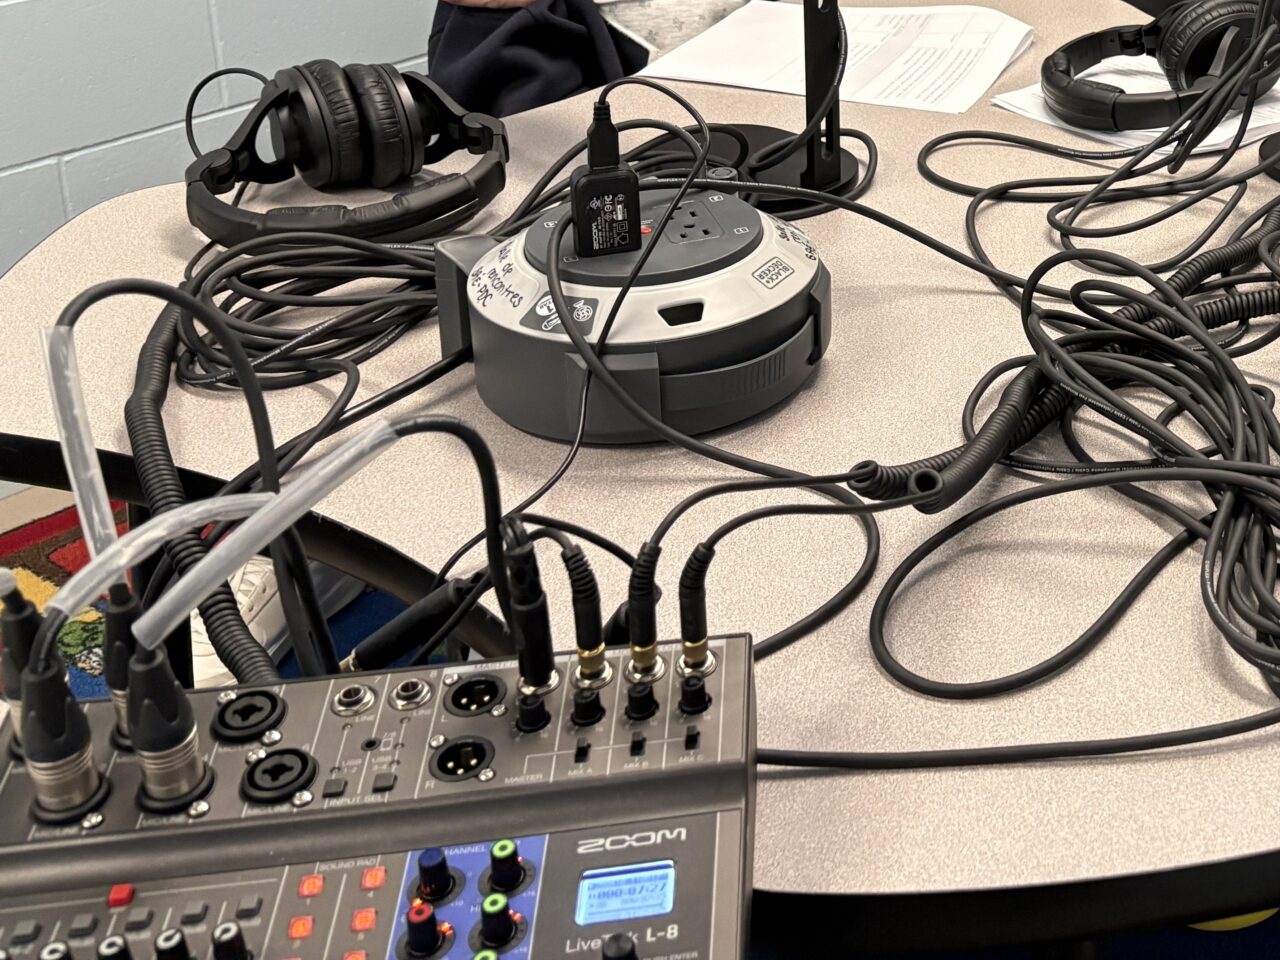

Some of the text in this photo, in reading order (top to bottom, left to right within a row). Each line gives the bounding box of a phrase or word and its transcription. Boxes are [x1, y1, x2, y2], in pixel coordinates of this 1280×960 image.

[757, 260, 782, 280] DECKER
[504, 773, 544, 785] MASTER
[329, 794, 384, 807] INPUT SEL
[577, 827, 687, 854] ZOOM
[445, 844, 488, 855] HANNEL
[320, 861, 353, 873] SOUND
[646, 924, 679, 941] L-8
